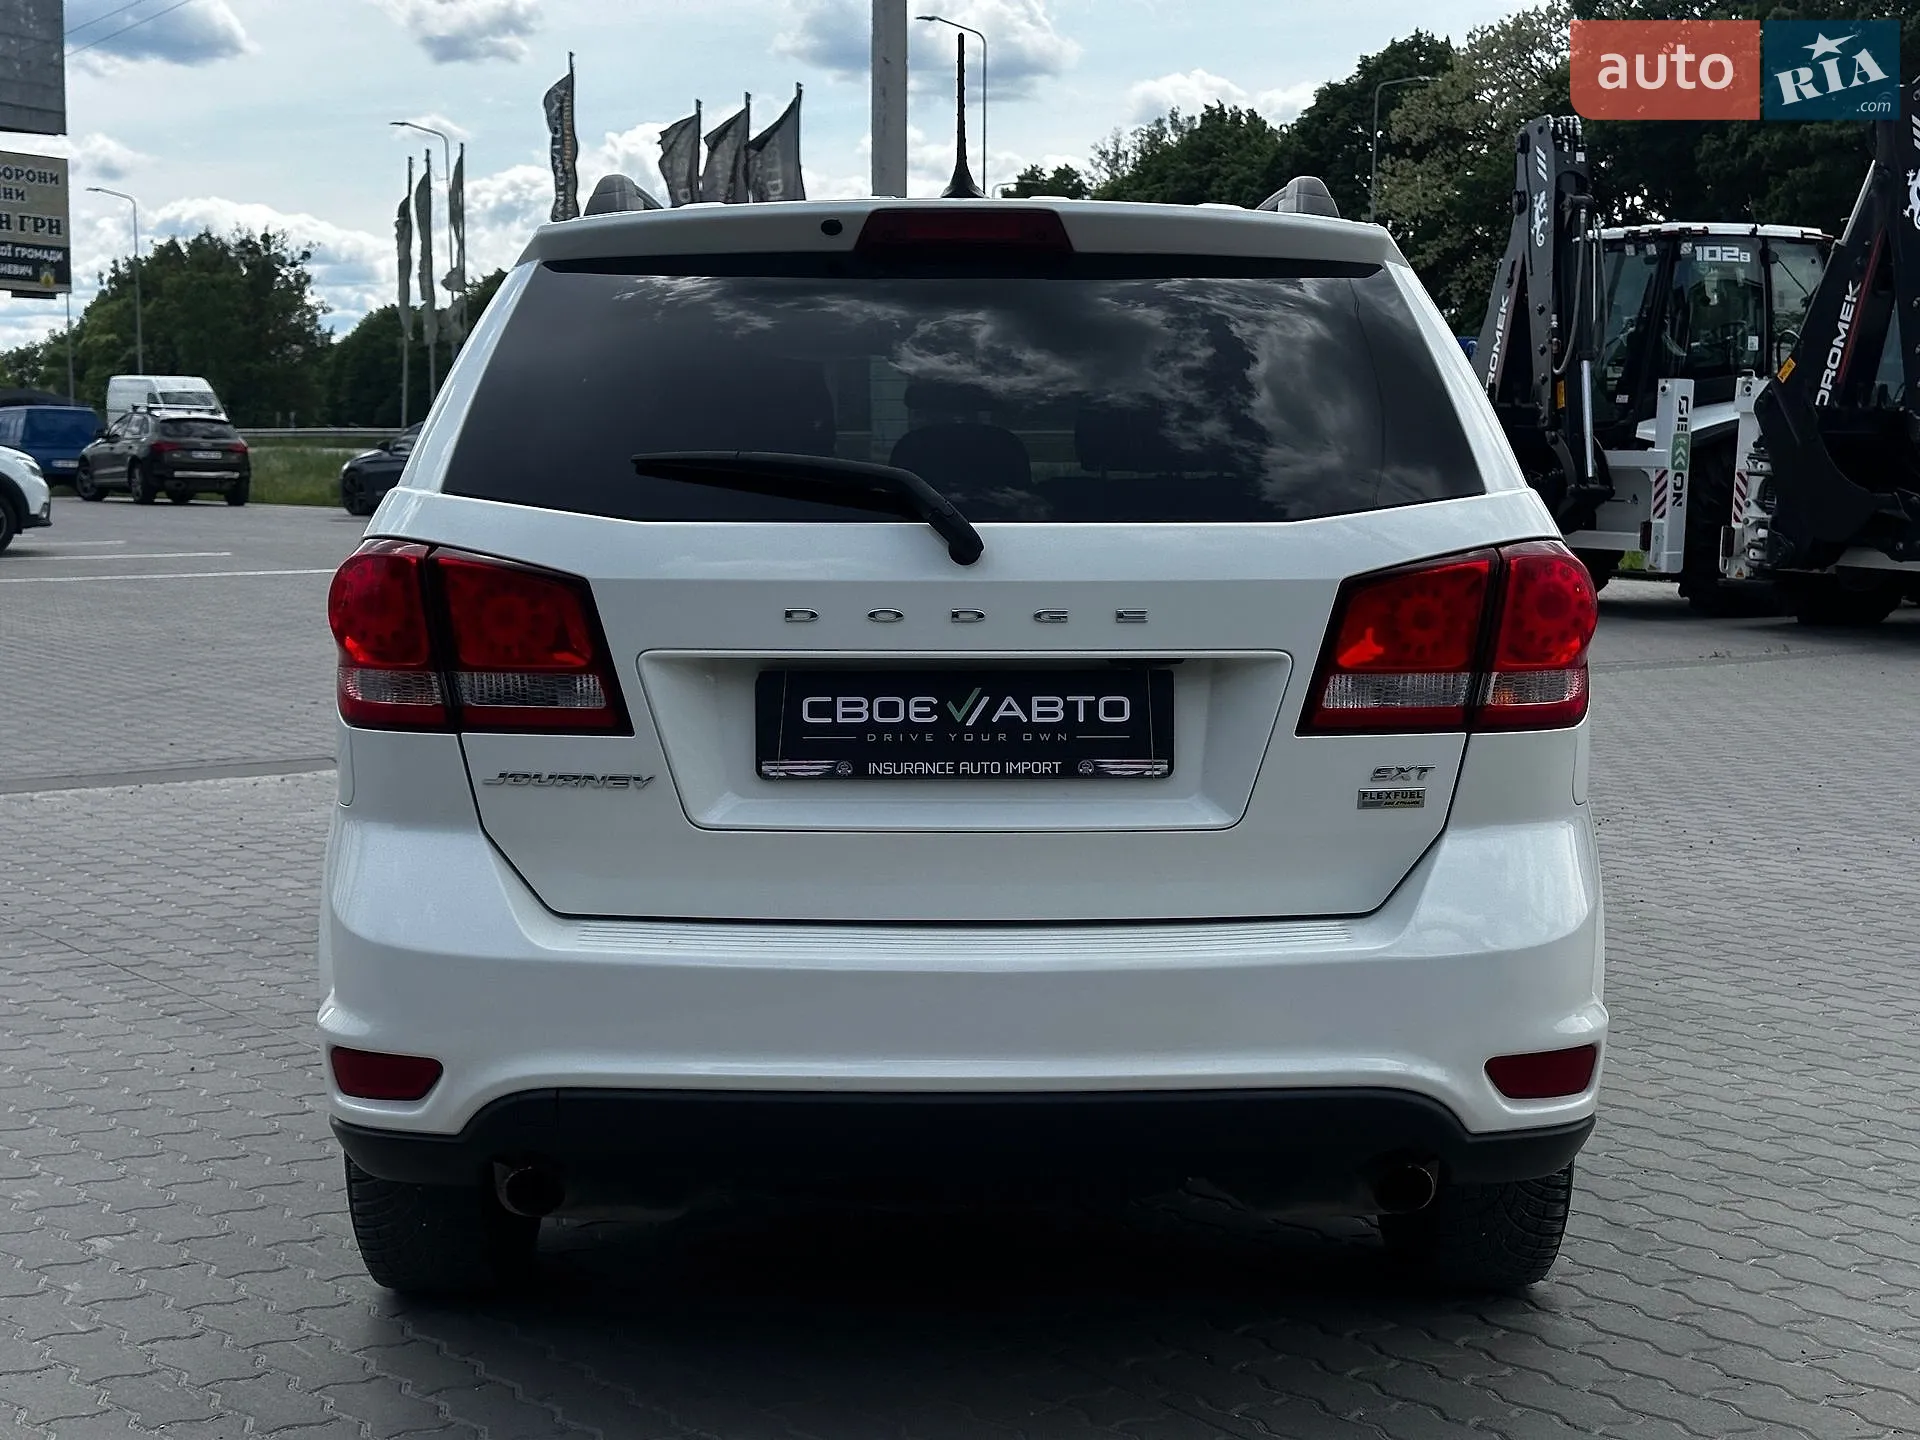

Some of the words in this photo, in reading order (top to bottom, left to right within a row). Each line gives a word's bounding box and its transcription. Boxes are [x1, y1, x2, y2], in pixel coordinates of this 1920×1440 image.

[0, 165, 59, 185] ОРОНИ
[18, 215, 62, 235] ГРН
[784, 608, 1149, 623] DODGE
[867, 733, 934, 742] DRIVE
[949, 733, 1007, 742] YOUR
[1023, 733, 1068, 742] OWN
[868, 761, 954, 775] INSURANCE
[960, 761, 1000, 775] AUTO
[1006, 761, 1062, 775] IMPORT
[1370, 764, 1436, 781] SXT
[483, 771, 657, 789] JOURNEY
